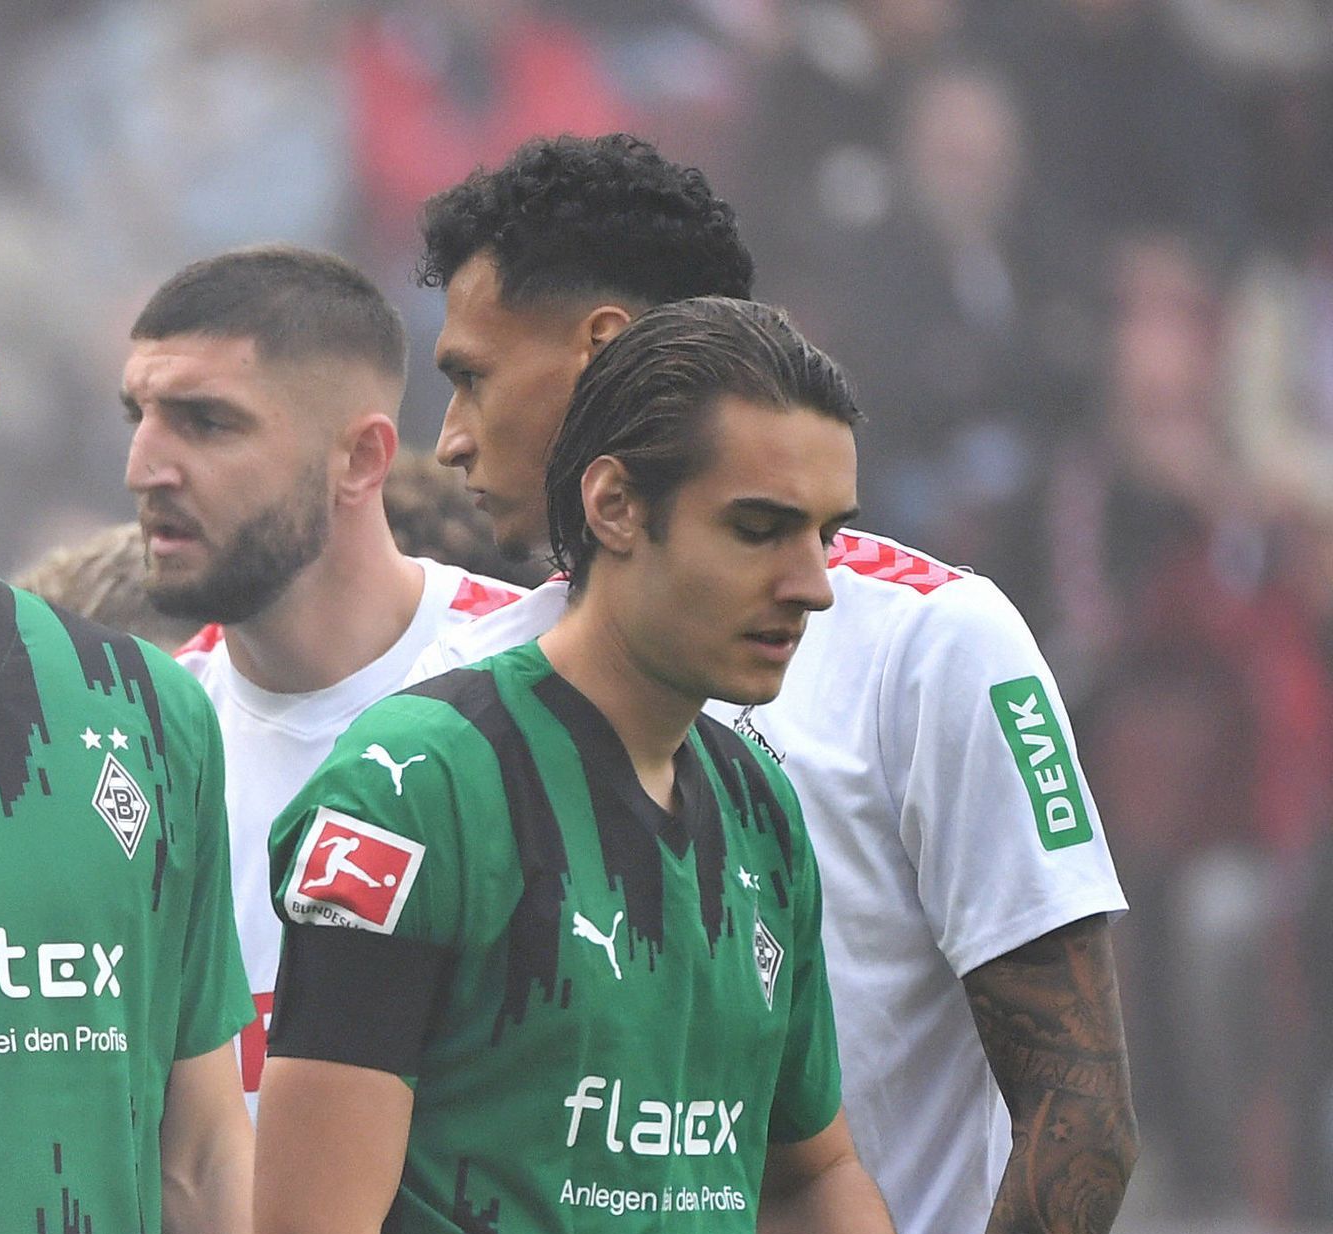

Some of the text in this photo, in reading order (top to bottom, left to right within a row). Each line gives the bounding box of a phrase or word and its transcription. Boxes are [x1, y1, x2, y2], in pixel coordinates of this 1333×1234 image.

[1006, 692, 1077, 833] DEVK
[24, 1026, 69, 1052] den
[76, 1026, 128, 1052] Profis
[559, 1178, 658, 1216] Anlegen
[701, 1186, 746, 1211] Profis
